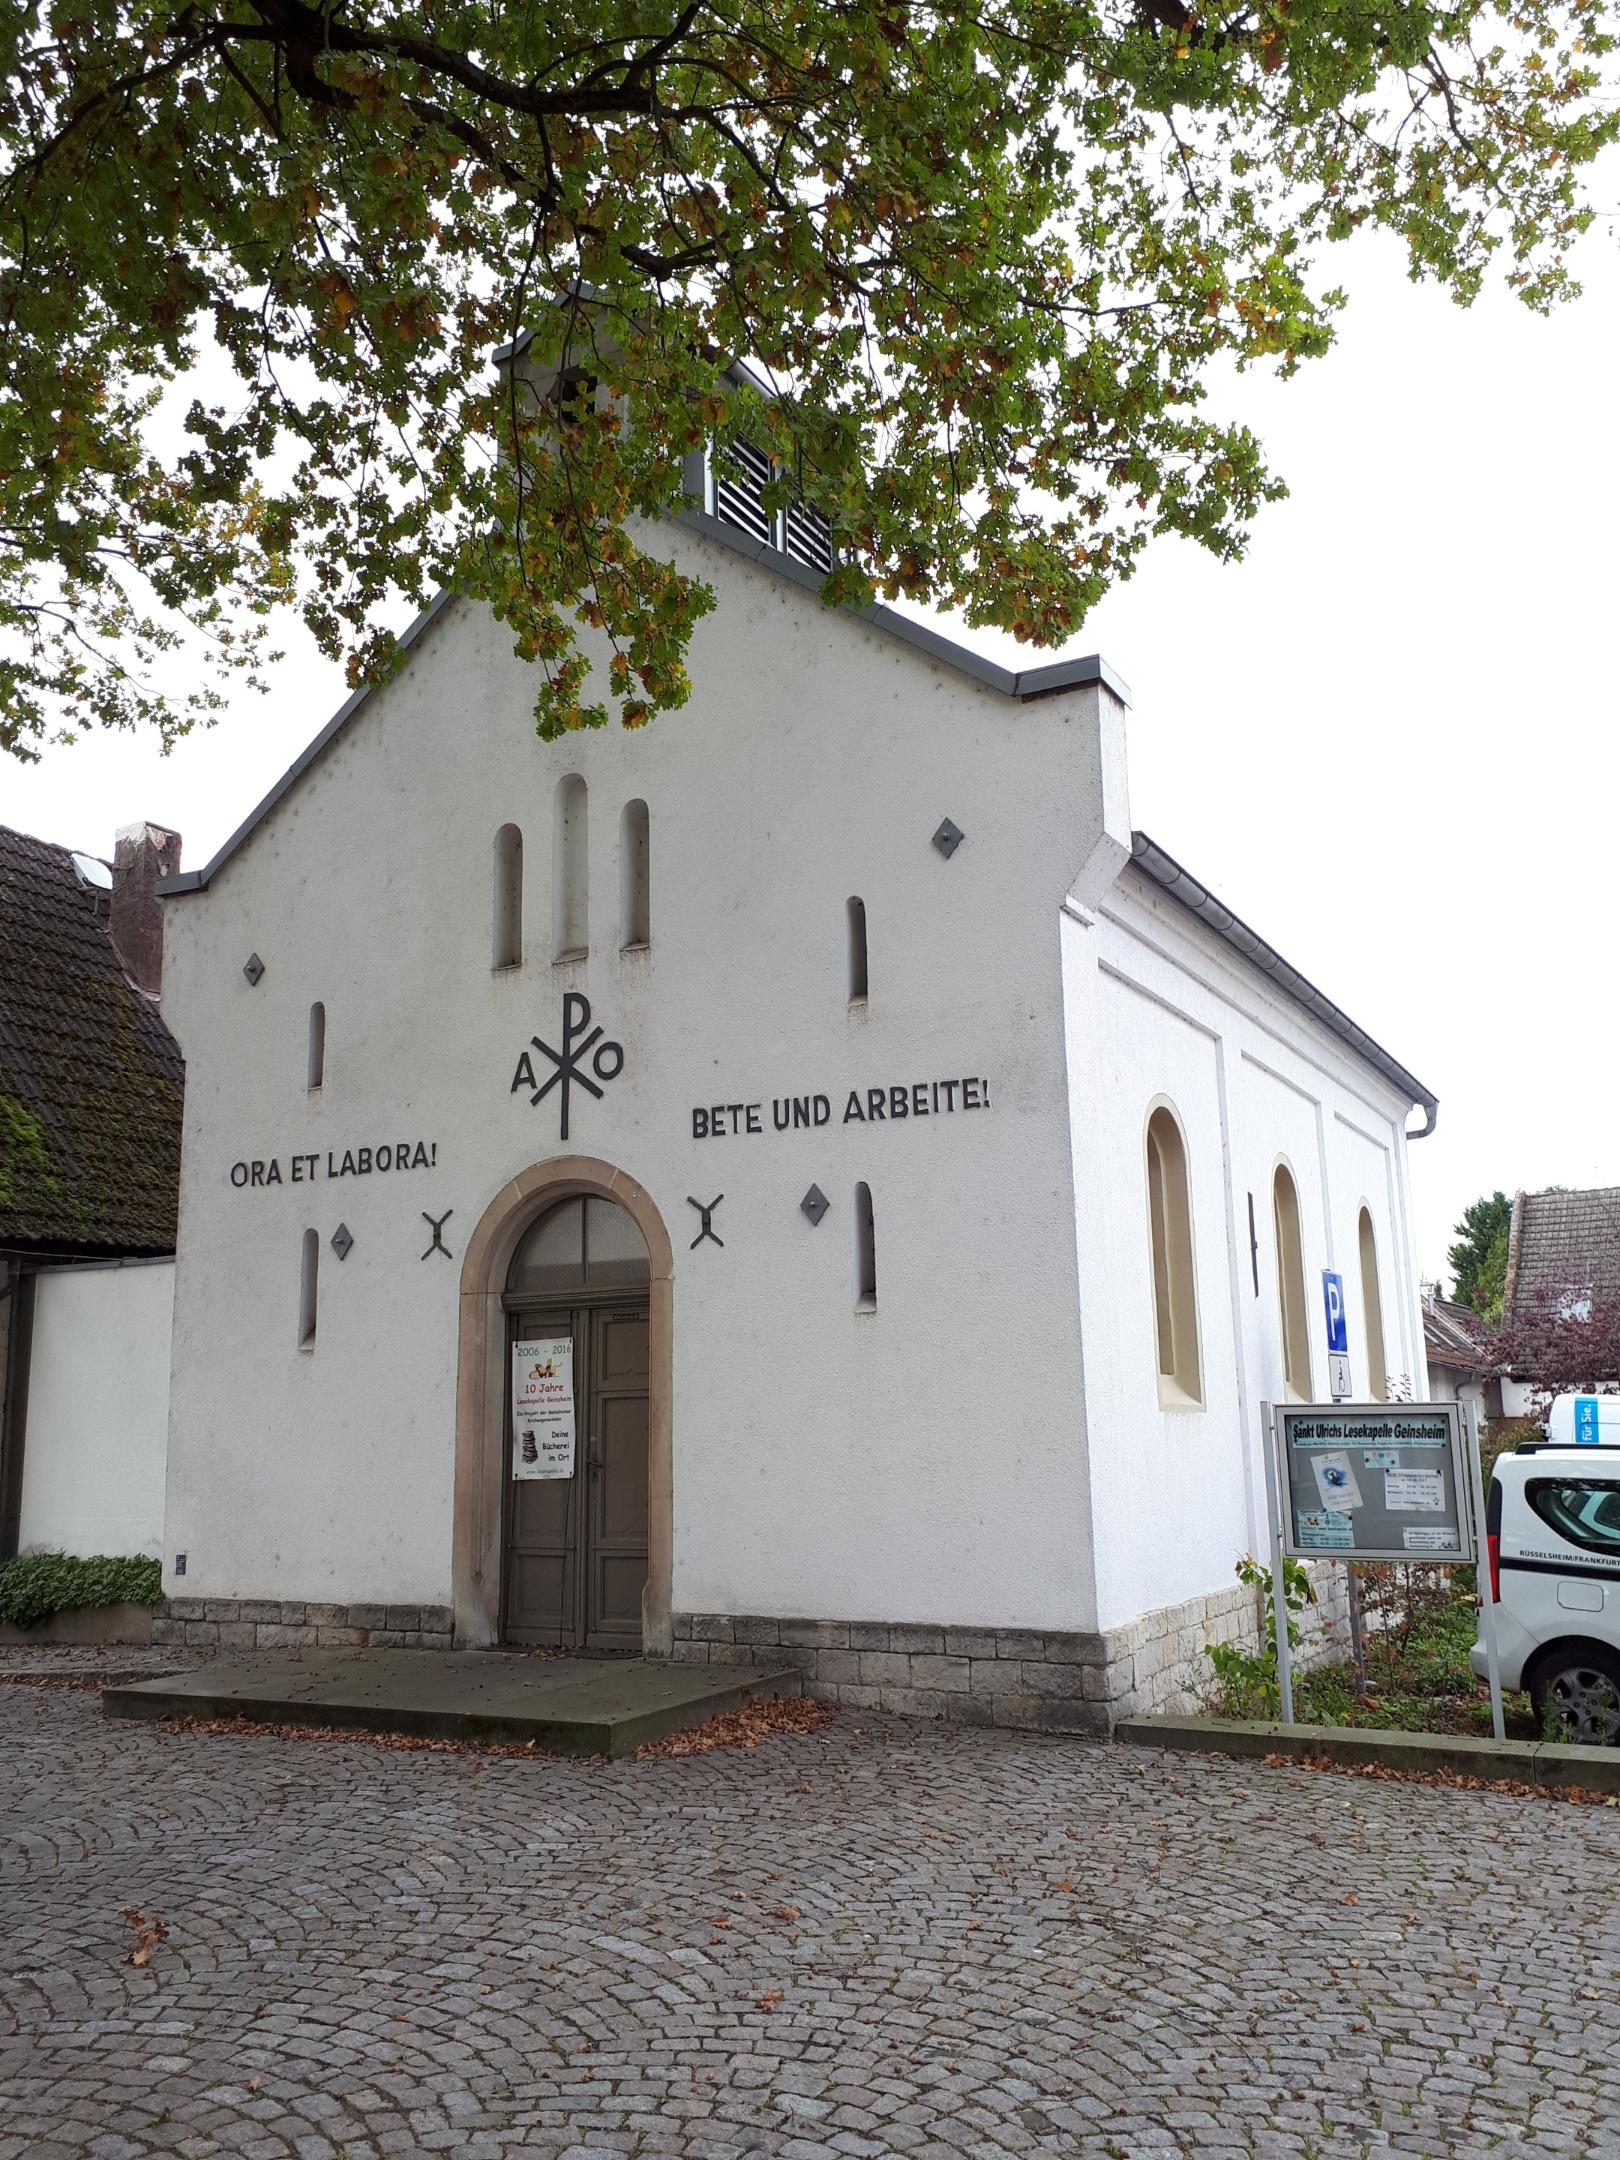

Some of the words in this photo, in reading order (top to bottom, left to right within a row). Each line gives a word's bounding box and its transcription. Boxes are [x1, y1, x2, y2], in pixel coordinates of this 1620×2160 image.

[692, 1104, 763, 1138] BETE
[773, 1094, 831, 1131] UND
[843, 1077, 990, 1124] ARBEITE!
[230, 1158, 283, 1188] ORA
[291, 1153, 320, 1183] ET
[327, 1141, 437, 1179] LABORA!
[1327, 1282, 1340, 1341] P
[517, 1347, 540, 1357] 2006
[552, 1345, 571, 1354] 2016
[525, 1384, 536, 1394] 10
[539, 1383, 564, 1392] Jahre
[1581, 1404, 1592, 1422] Sie.
[551, 1430, 569, 1439] Deine
[1293, 1423, 1315, 1438] Sankt
[1316, 1423, 1342, 1438] Ulrichs
[1343, 1423, 1393, 1442] Lesekapelle
[1394, 1423, 1445, 1439] Geinsheim
[1581, 1424, 1593, 1442] für
[542, 1442, 570, 1450] Bücherei
[557, 1453, 570, 1461] Ort
